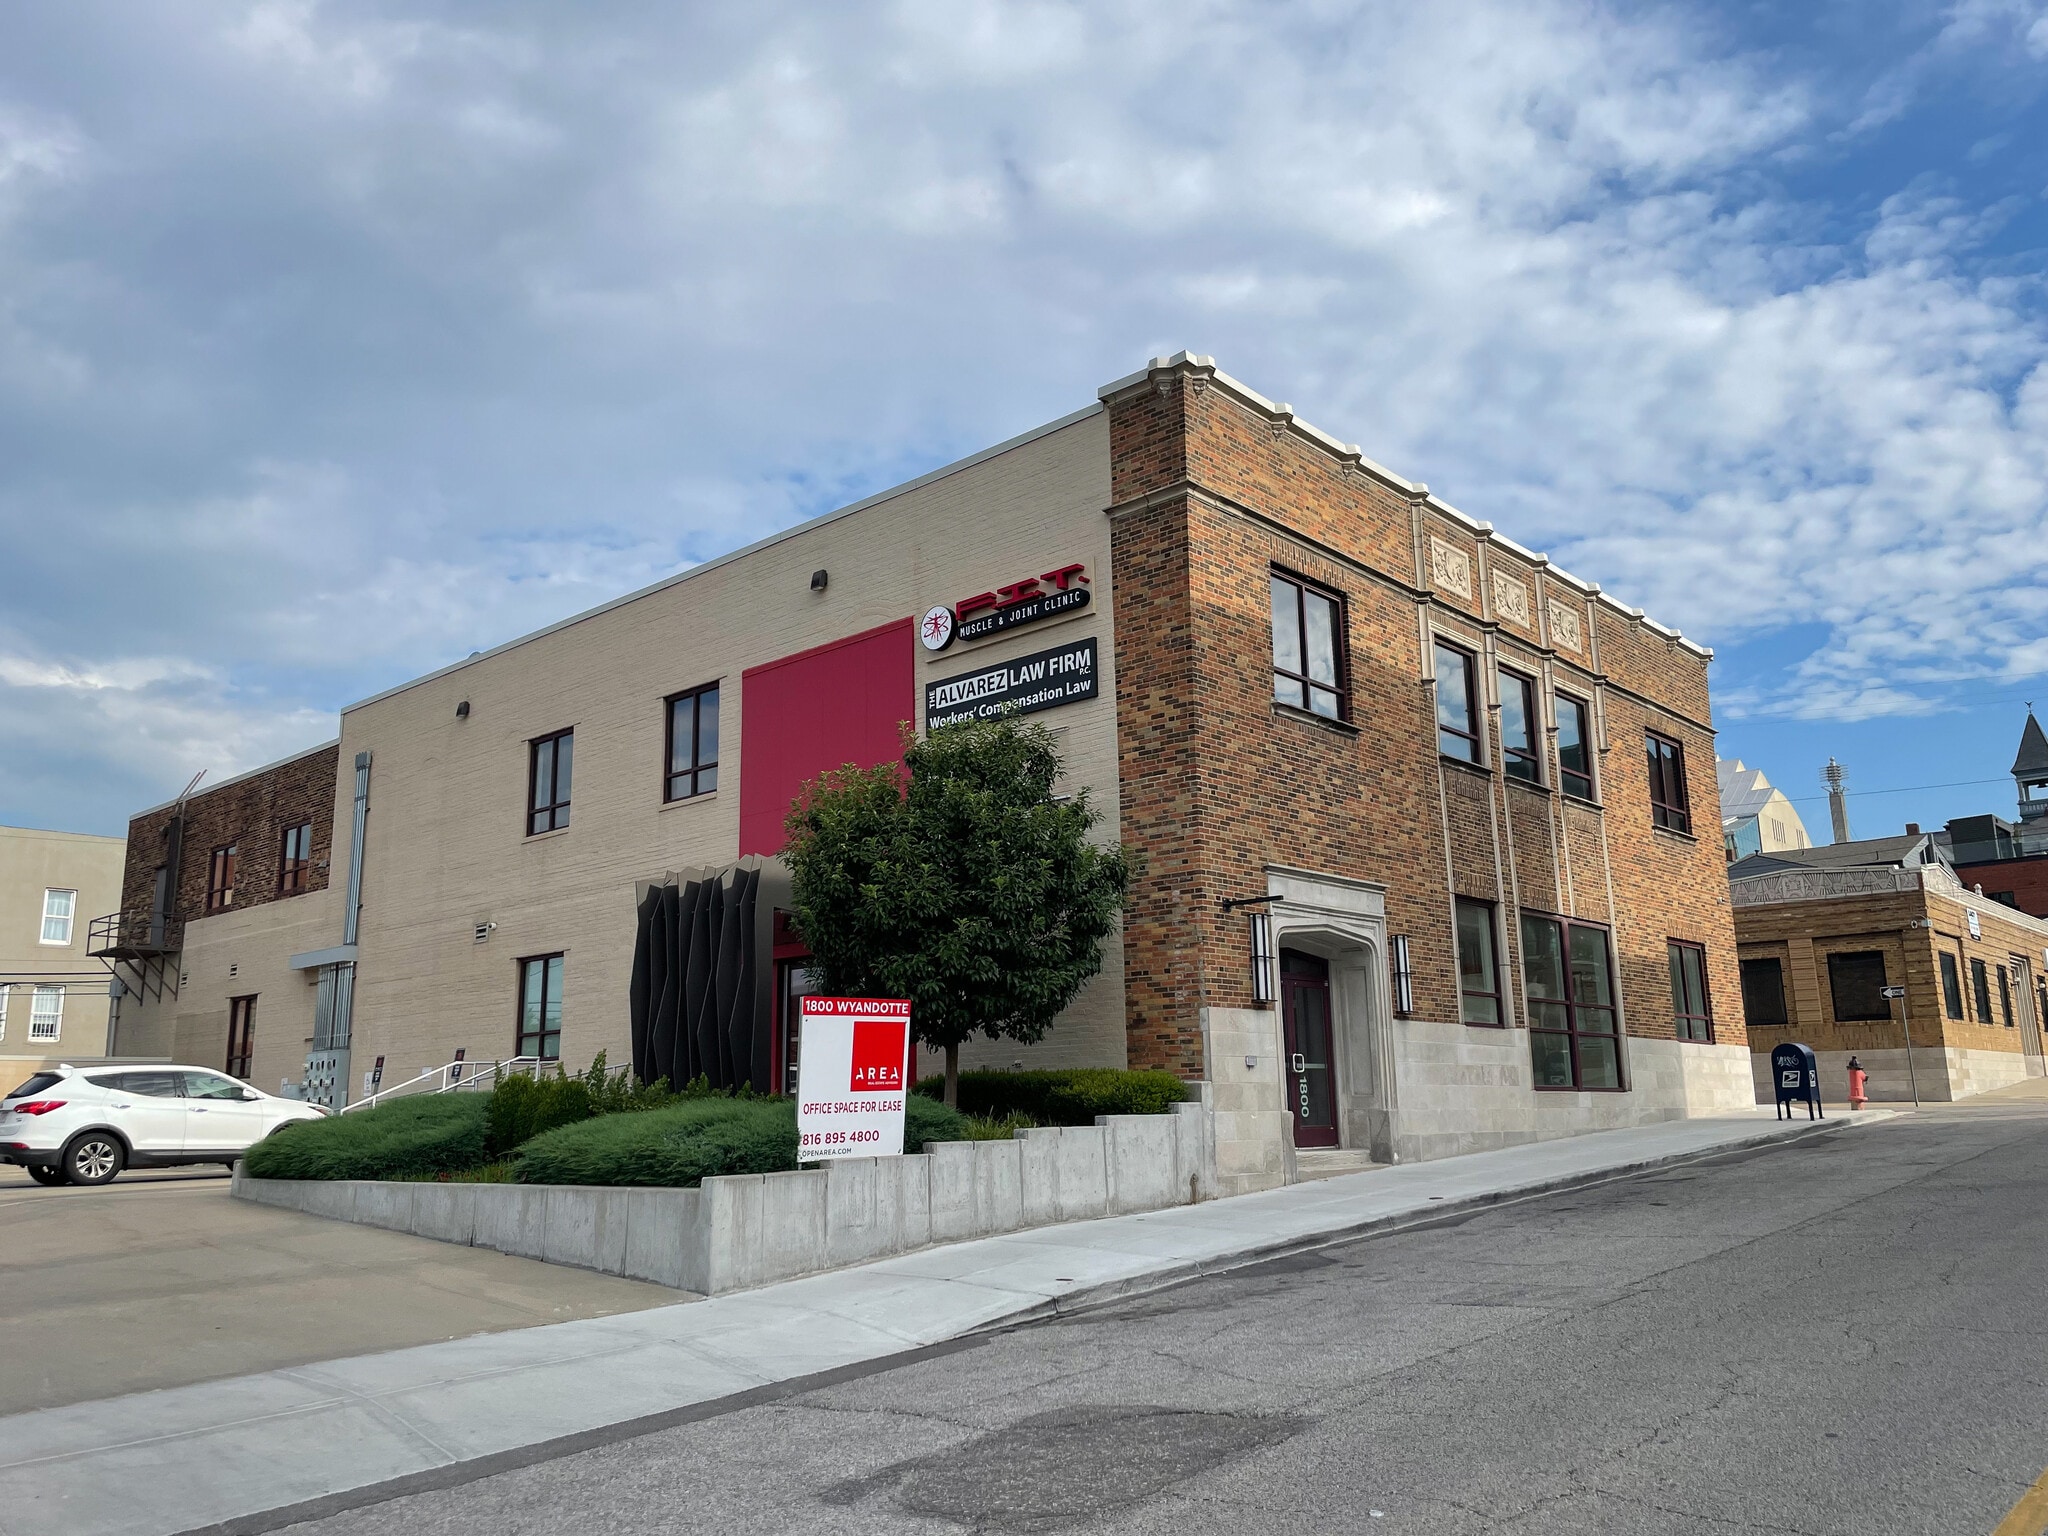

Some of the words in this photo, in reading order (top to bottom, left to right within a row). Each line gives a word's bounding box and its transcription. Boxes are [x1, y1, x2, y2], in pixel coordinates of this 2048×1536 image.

[960, 620, 993, 637] MUSCLE
[998, 616, 1004, 626] &
[1010, 604, 1038, 622] JOINT
[1044, 591, 1080, 611] CLINIC
[939, 673, 1005, 705] ALVAREZ
[1010, 661, 1045, 687] LAW
[1050, 648, 1091, 676] FIRM
[1079, 667, 1091, 675] P.C.
[1066, 679, 1091, 696] Law
[805, 1000, 834, 1012] 1800
[837, 1001, 909, 1014] WYANDOTTE
[855, 1066, 899, 1080] AREA
[1300, 1076, 1309, 1117] 1800
[803, 1102, 832, 1115] OFFICE
[833, 1101, 858, 1114] SPACE
[860, 1101, 876, 1112] FOR
[878, 1100, 902, 1112] LEASE
[802, 1133, 821, 1145] 816
[825, 1131, 846, 1144] 895
[849, 1130, 880, 1142] 4800
[802, 1147, 852, 1157] OPENAREA.COM
